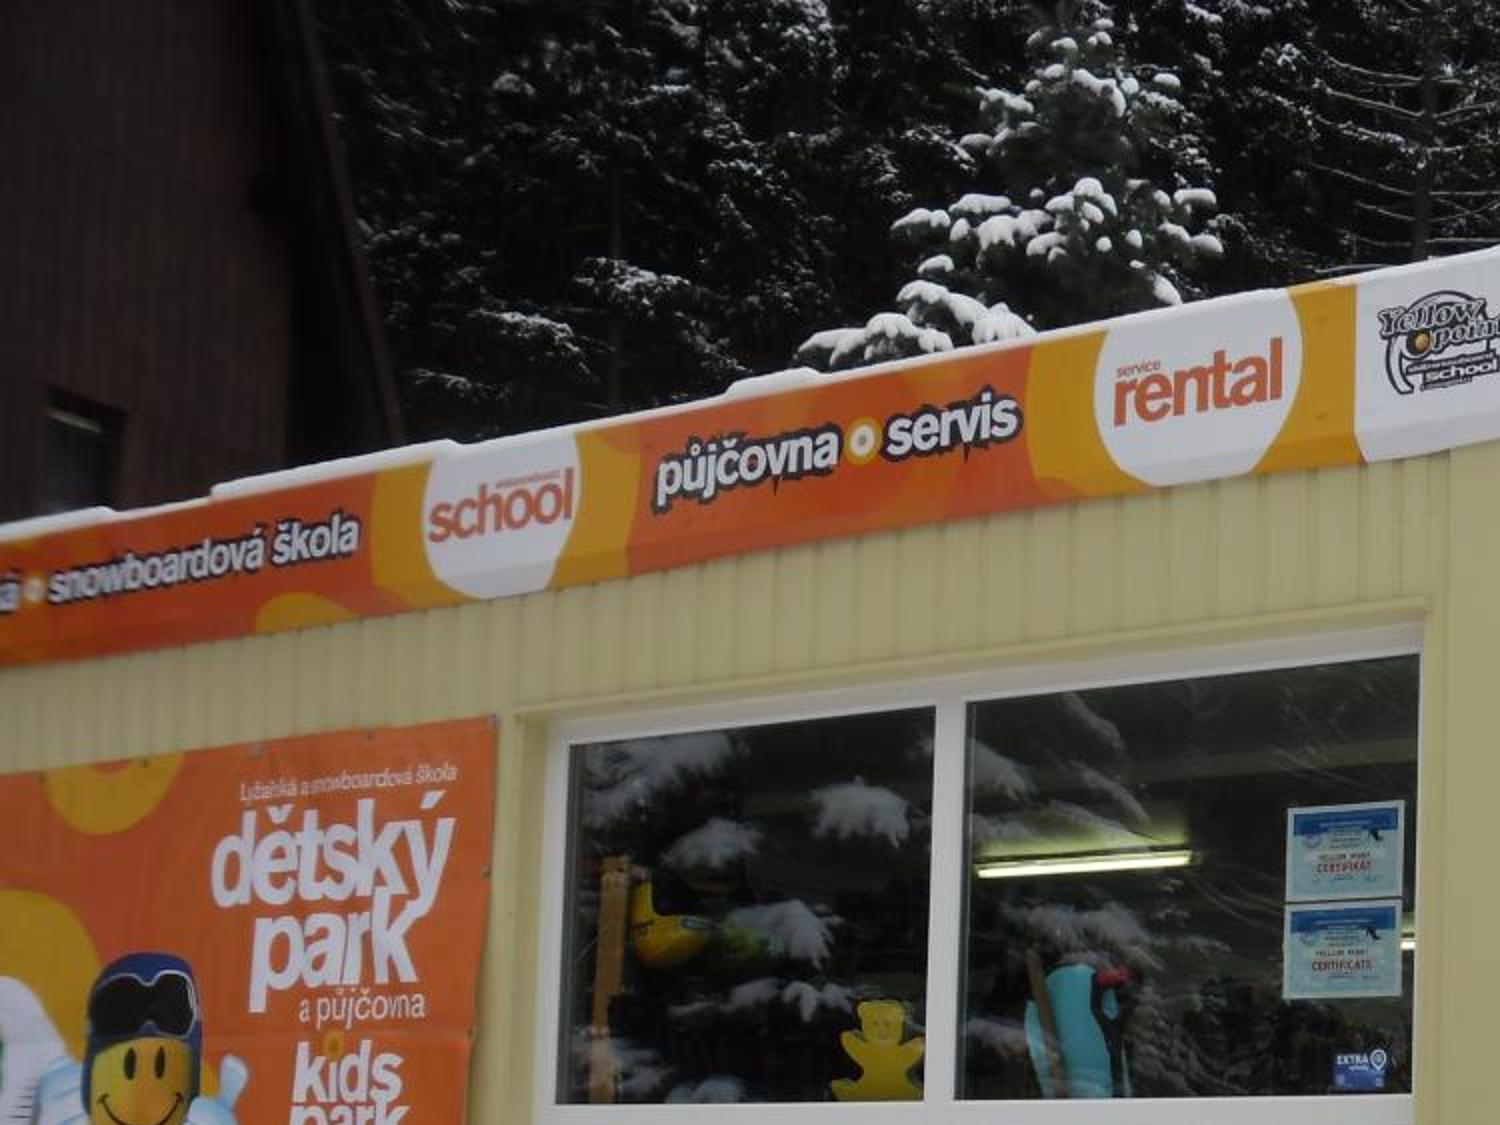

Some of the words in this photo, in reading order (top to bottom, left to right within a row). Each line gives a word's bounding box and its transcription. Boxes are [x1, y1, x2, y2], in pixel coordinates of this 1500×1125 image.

[1113, 336, 1285, 428] rental
[1115, 358, 1162, 378] service
[655, 427, 840, 506] půjčovna
[885, 389, 1021, 456] servis
[428, 466, 575, 543] school
[50, 527, 267, 604] snowboardová
[271, 512, 361, 566] škola
[210, 789, 457, 921] dětský
[248, 884, 418, 1014] park
[299, 999, 310, 1024] a
[316, 985, 426, 1031] půjčovna
[291, 1038, 404, 1103] kids
